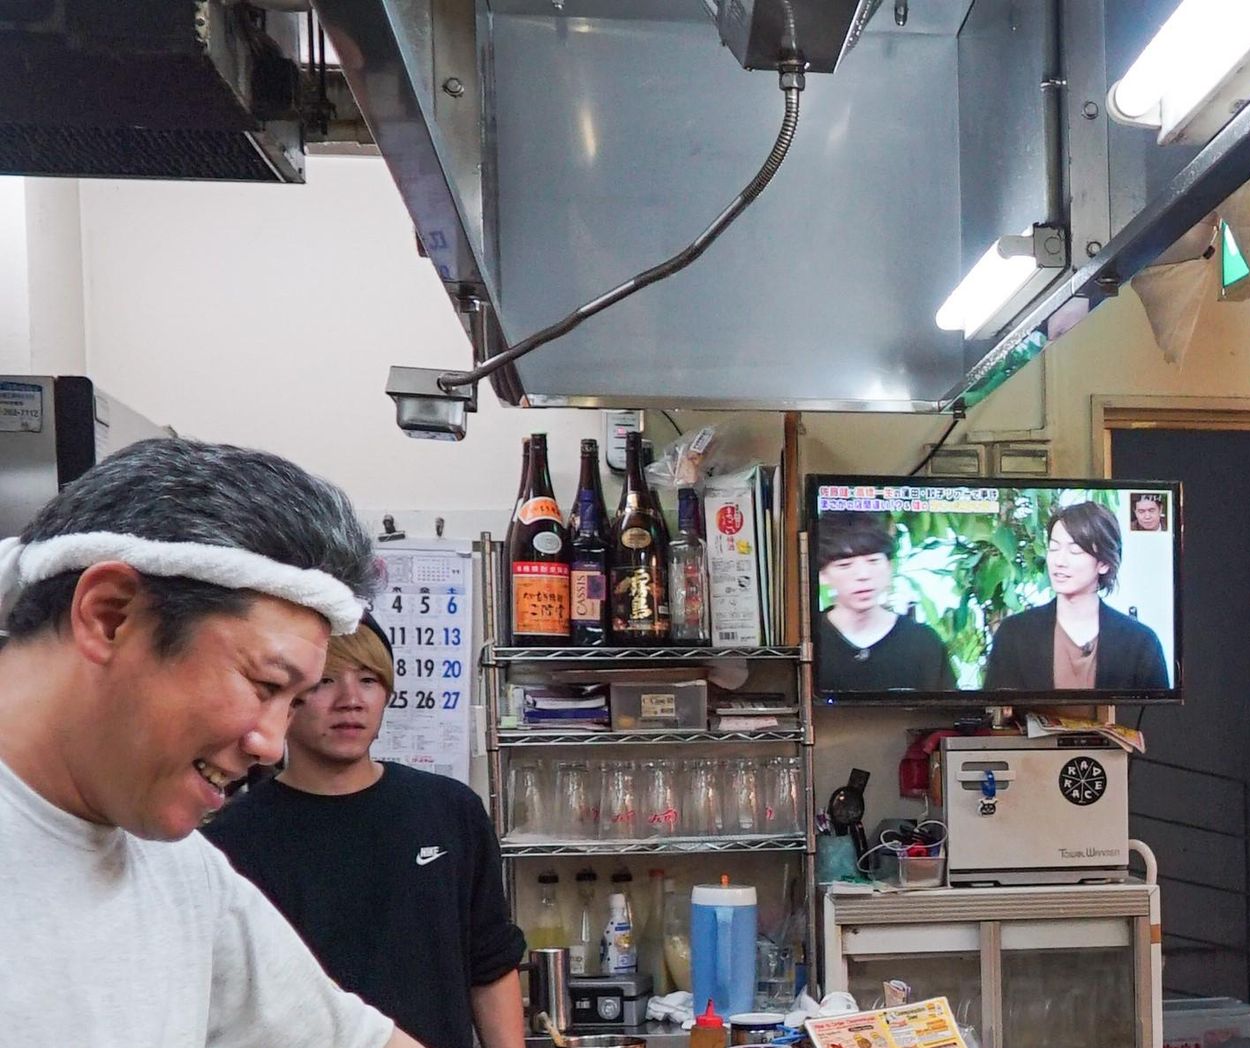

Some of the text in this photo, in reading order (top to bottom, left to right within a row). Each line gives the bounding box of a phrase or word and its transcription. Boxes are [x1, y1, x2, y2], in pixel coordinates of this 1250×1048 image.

[391, 595, 403, 613] 4
[419, 596, 431, 614] 5
[447, 597, 457, 614] 6
[575, 574, 588, 617] CASSIS
[389, 627, 461, 646] 11 12 13
[415, 658, 435, 677] 19
[442, 659, 461, 678] 20
[389, 690, 460, 710] 25 26 27
